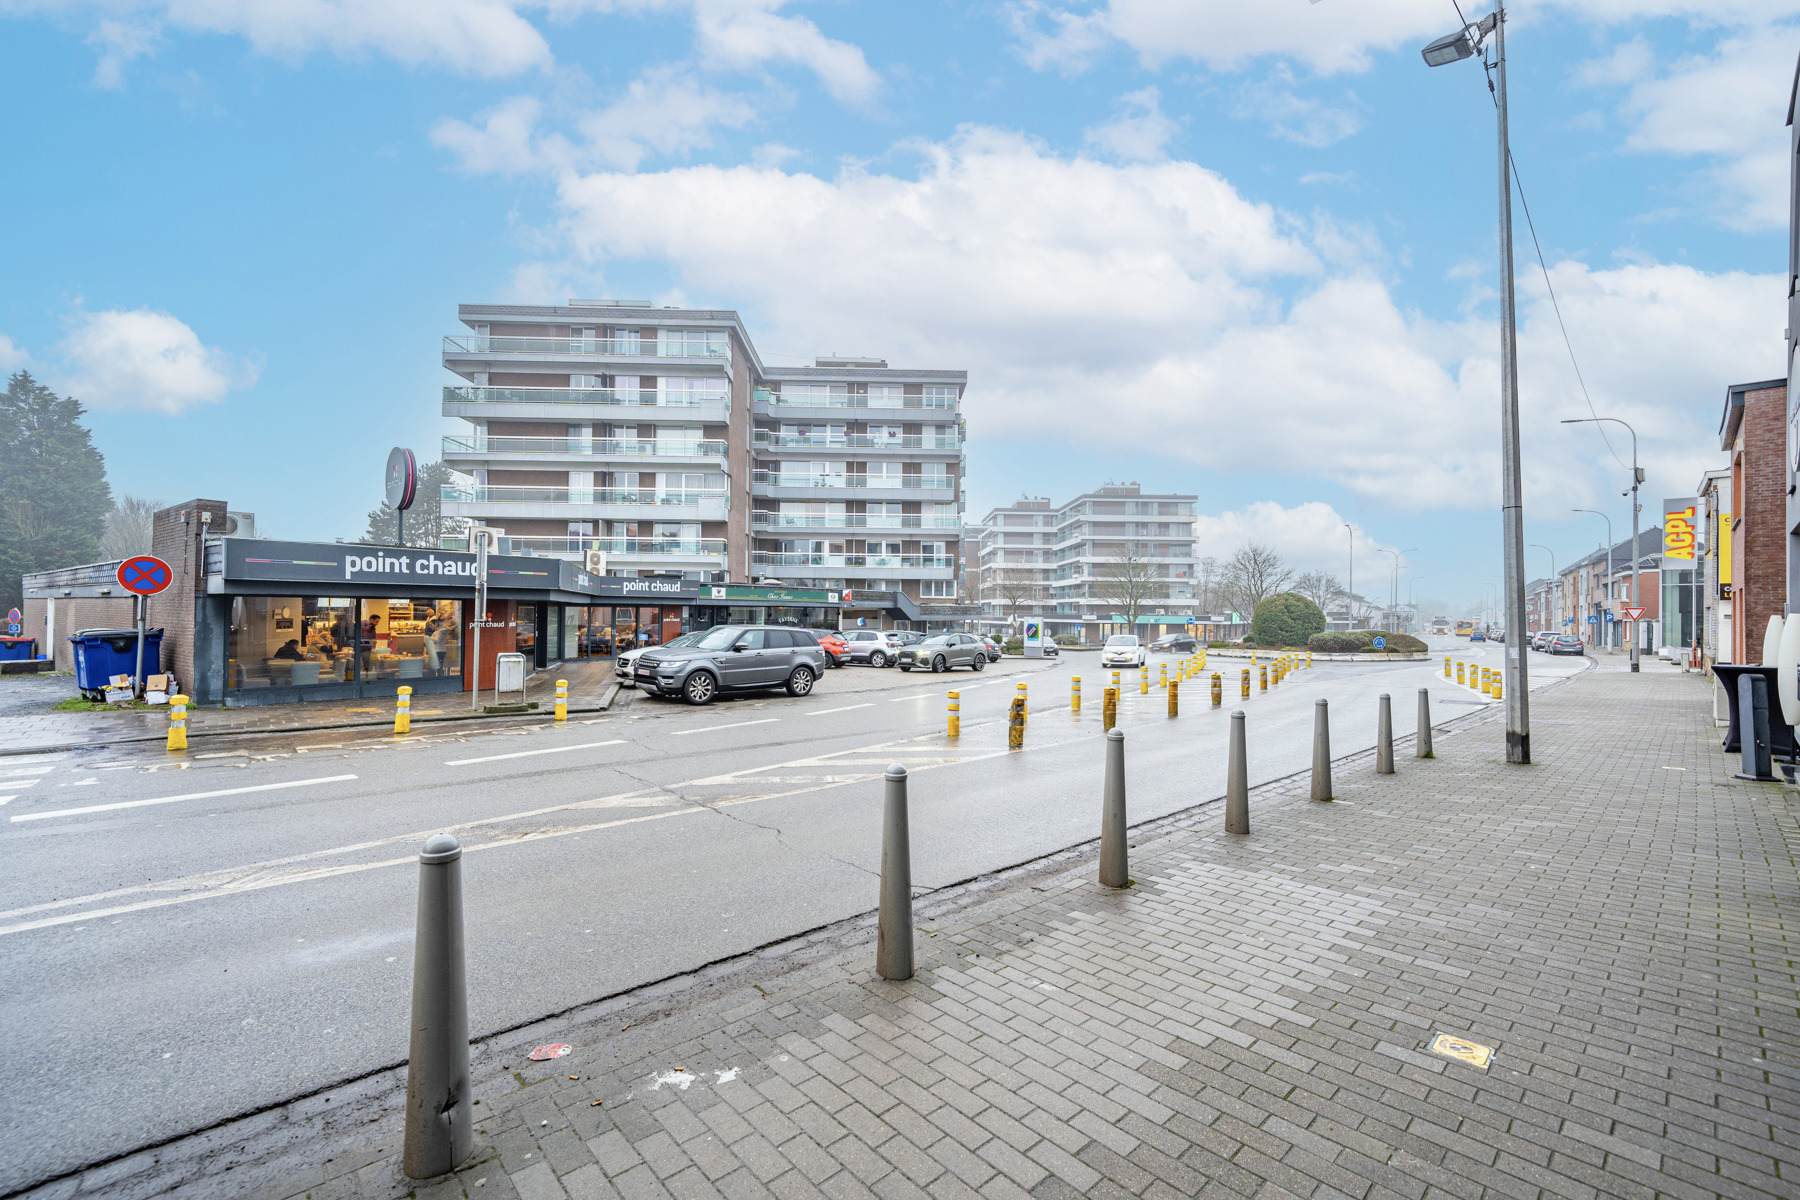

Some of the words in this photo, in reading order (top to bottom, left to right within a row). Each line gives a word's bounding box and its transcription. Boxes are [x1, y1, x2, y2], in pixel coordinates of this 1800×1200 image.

[1664, 506, 1696, 560] ACPL
[345, 551, 410, 580] point
[623, 579, 650, 595] point
[651, 580, 681, 592] chaud
[469, 621, 485, 630] pnt
